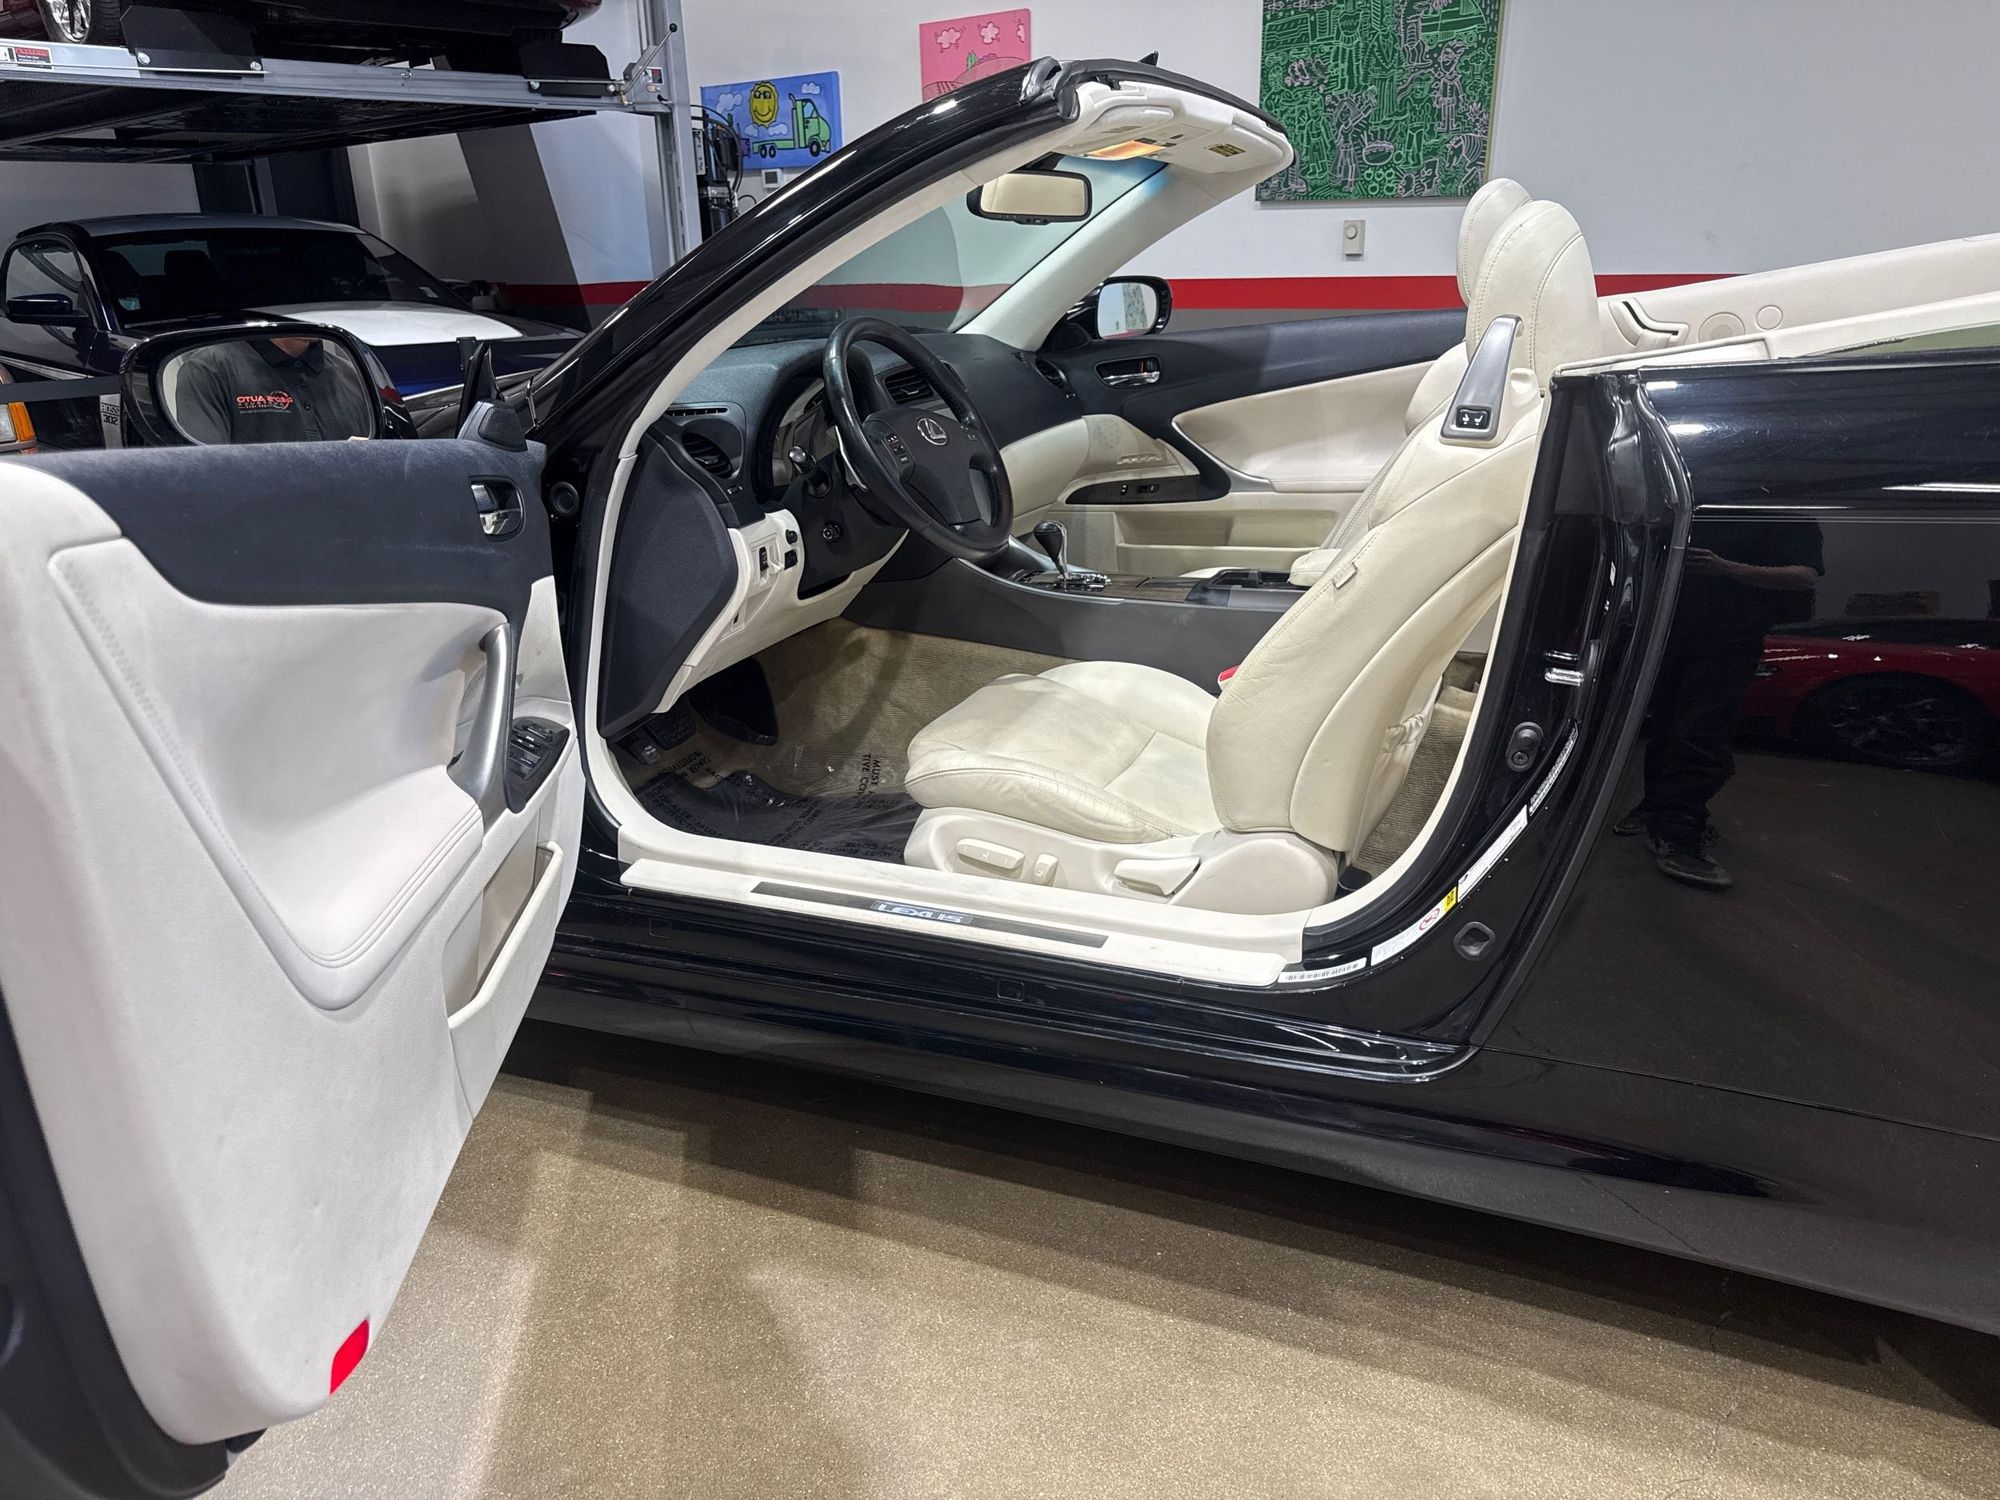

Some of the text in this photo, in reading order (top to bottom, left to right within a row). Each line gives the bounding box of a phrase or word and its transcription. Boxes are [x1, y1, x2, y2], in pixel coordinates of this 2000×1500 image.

[100, 402, 120, 416] BOSS
[103, 414, 119, 426] 302
[862, 754, 871, 772] TIVE
[871, 760, 881, 785] MUST
[878, 903, 963, 923] LEXUS
